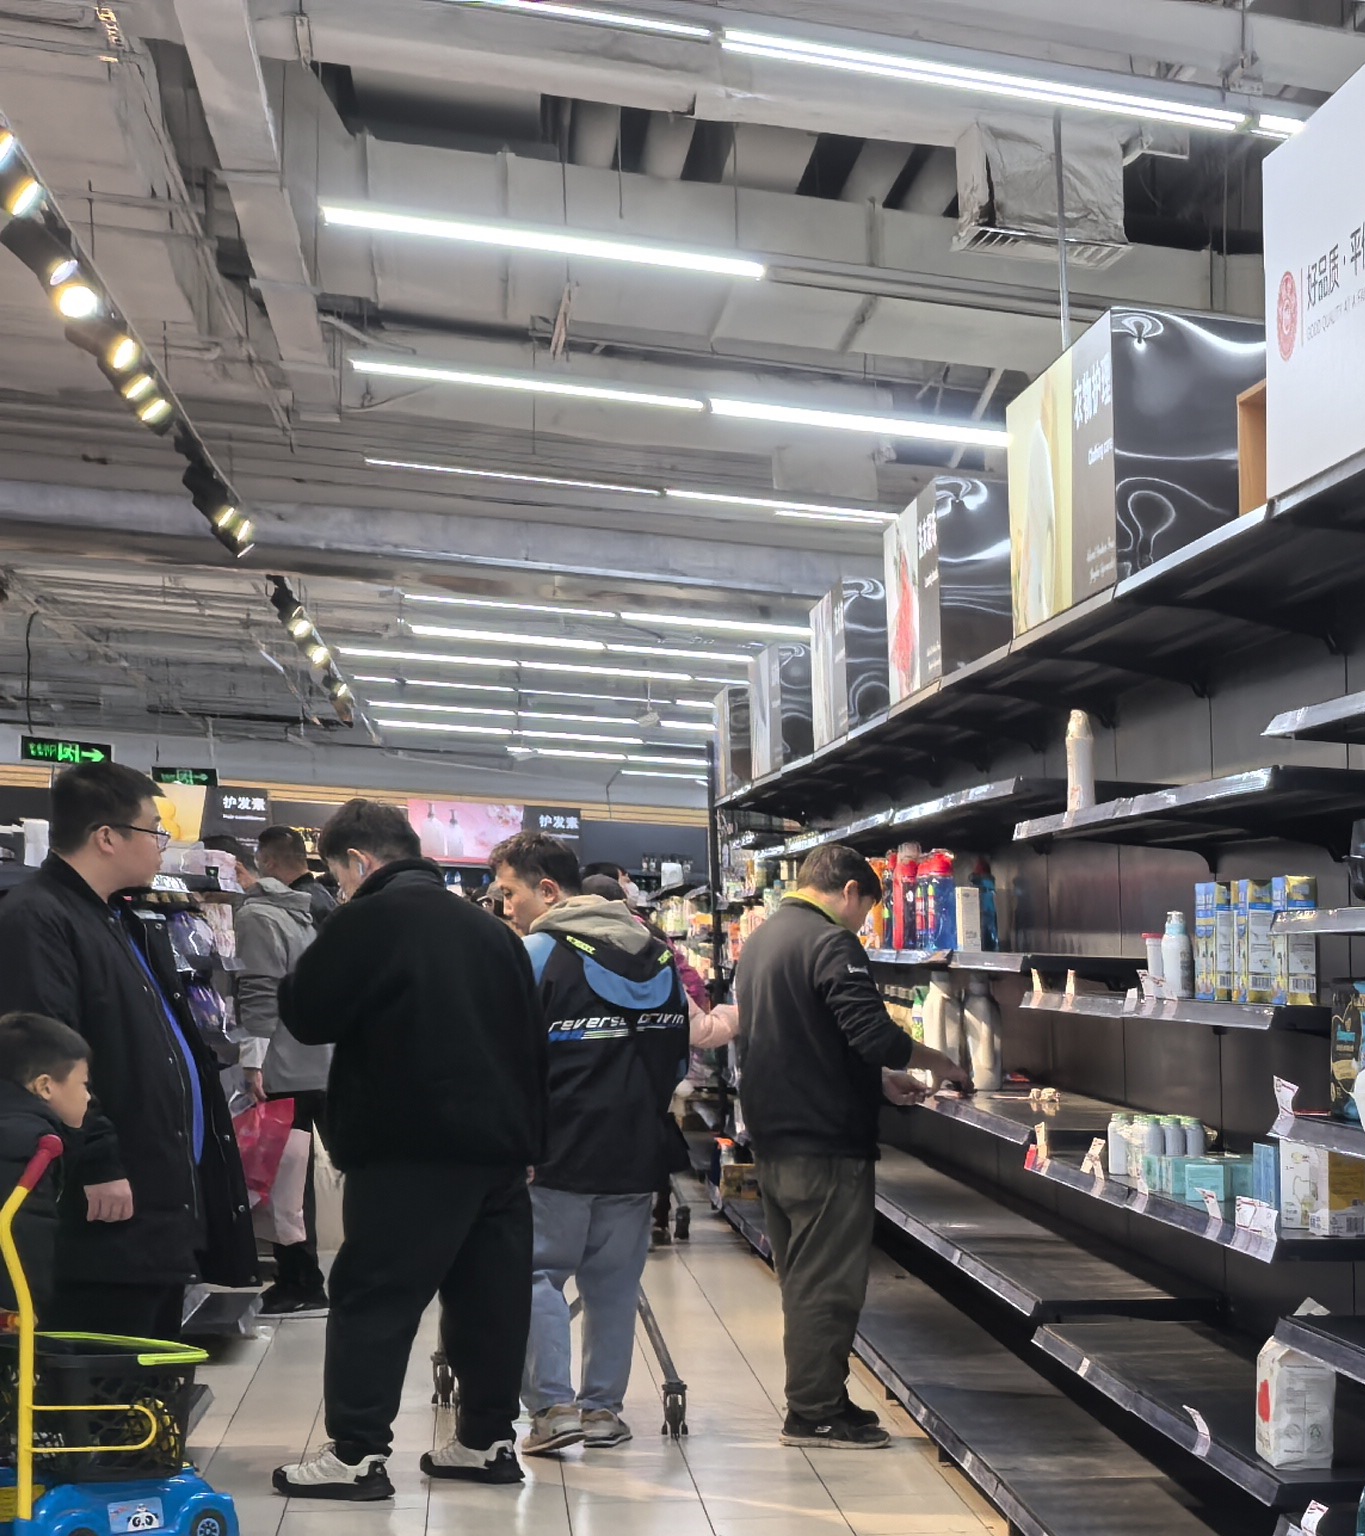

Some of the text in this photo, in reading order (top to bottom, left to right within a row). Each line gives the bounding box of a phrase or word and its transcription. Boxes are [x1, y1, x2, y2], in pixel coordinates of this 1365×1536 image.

[222, 795, 266, 811] 护发素
[539, 814, 579, 830] 护发素
